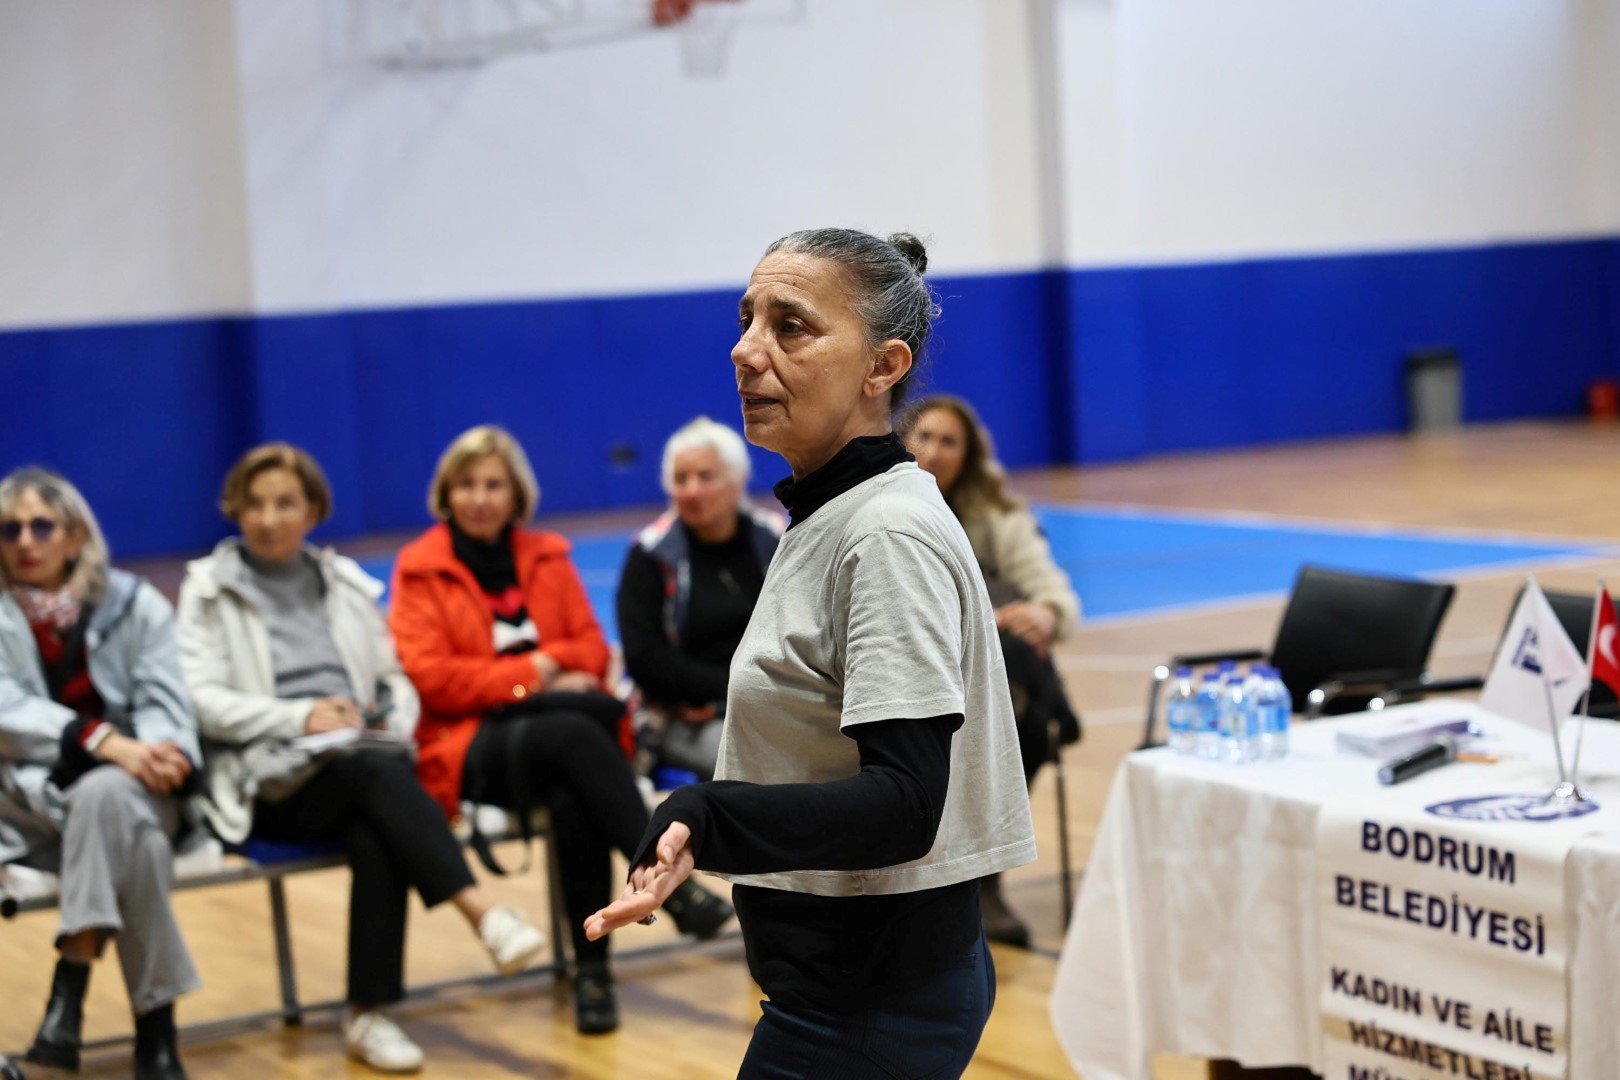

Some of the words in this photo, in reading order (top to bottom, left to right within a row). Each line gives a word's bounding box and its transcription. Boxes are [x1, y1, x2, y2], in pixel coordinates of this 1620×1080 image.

[1361, 820, 1516, 885] BODRUM
[1335, 874, 1546, 956] BELEDİYESİ
[1331, 966, 1423, 1016] KADIN
[1432, 994, 1473, 1031] VE
[1483, 1008, 1556, 1054] AİLE
